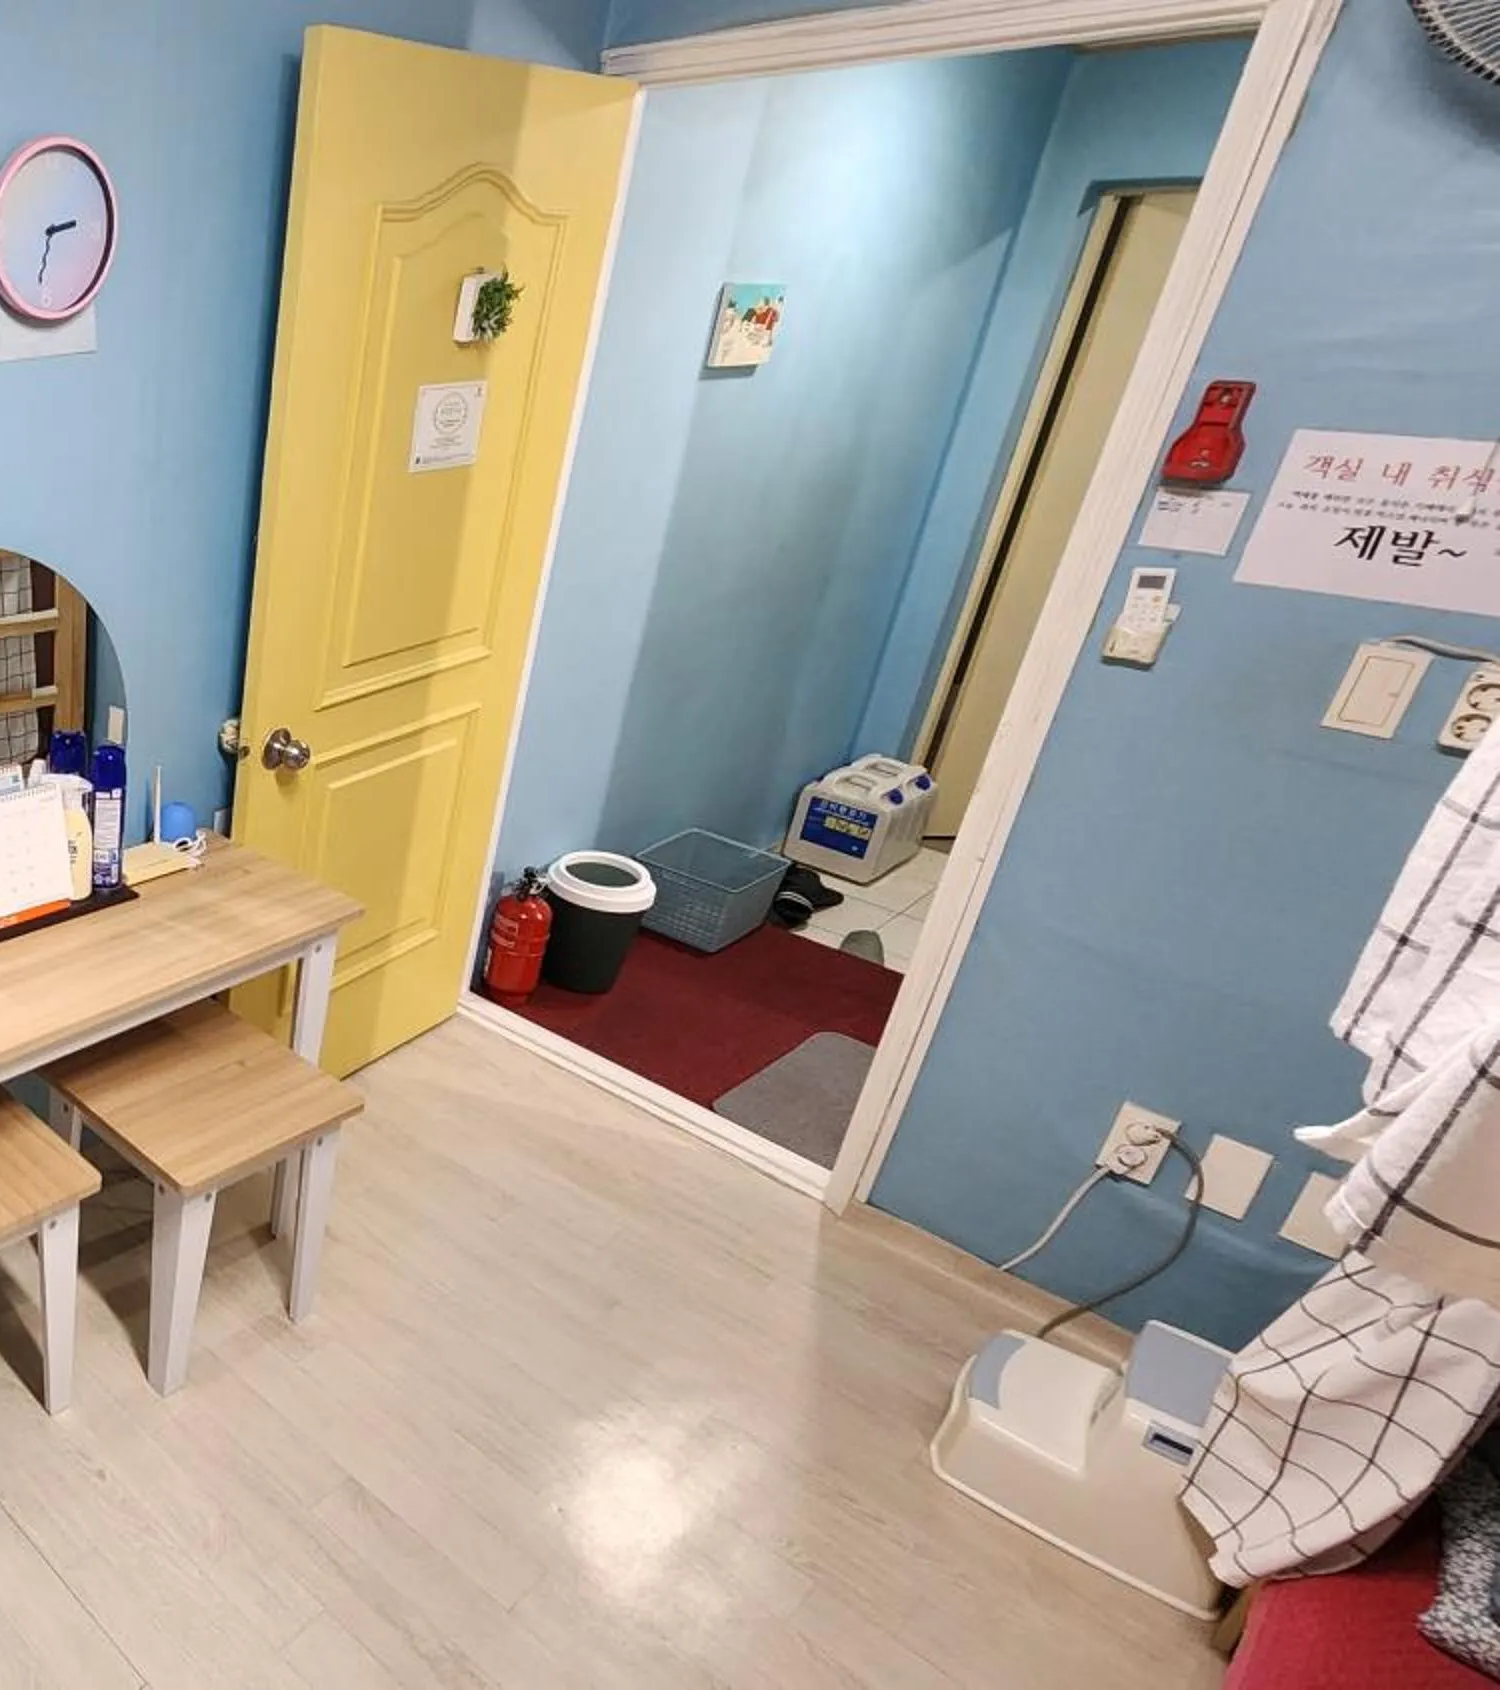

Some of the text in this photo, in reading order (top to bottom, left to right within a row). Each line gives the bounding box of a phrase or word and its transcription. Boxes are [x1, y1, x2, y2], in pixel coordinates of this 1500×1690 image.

[1303, 455, 1364, 482] 객실
[1382, 462, 1412, 487] 내
[1333, 525, 1468, 567] 제발~
